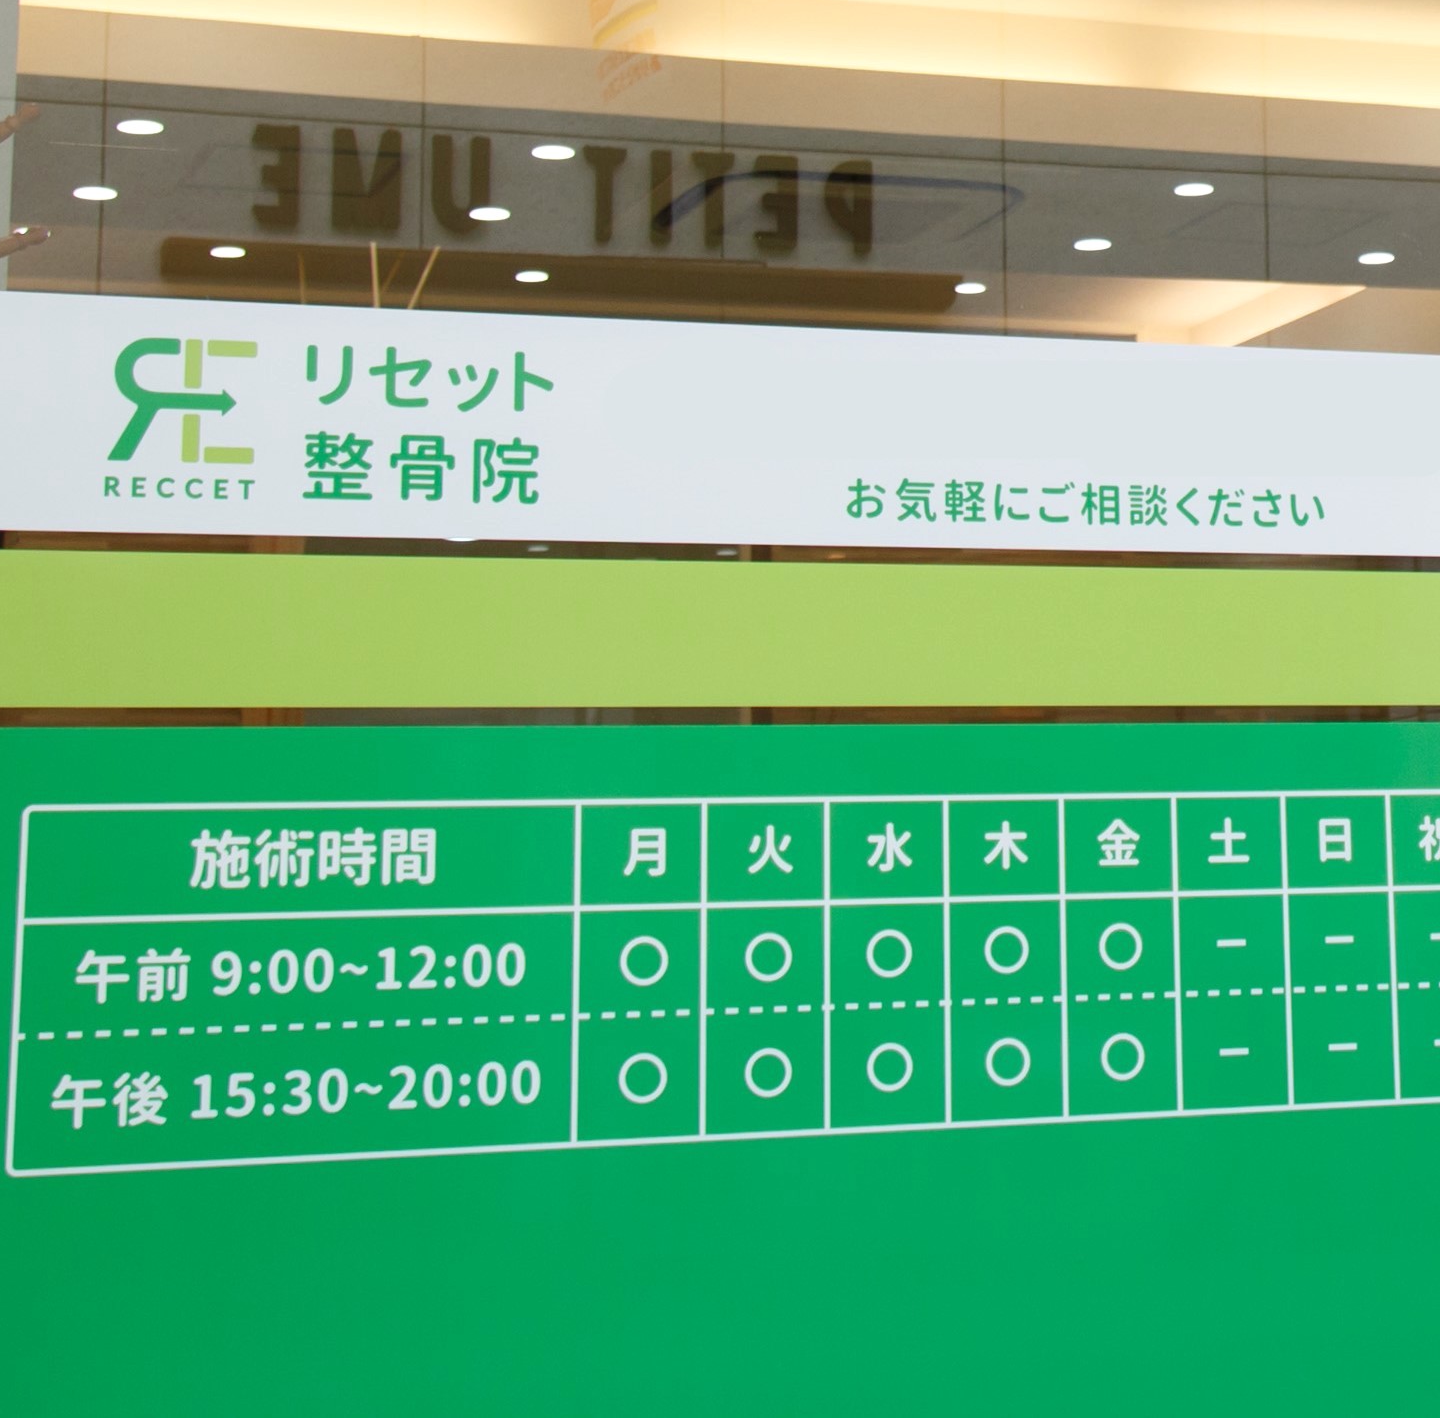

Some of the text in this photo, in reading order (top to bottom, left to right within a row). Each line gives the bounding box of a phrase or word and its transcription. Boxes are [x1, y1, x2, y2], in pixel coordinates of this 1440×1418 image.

[305, 344, 554, 412] リセット
[103, 475, 256, 500] RECCET
[302, 430, 541, 505] 整骨院
[845, 477, 1326, 528] お気軽にご相談ください
[188, 826, 438, 890] 施術時間
[623, 827, 668, 878] 月
[746, 823, 795, 876] 火
[866, 822, 914, 872] 水
[982, 820, 1029, 870] 木
[1096, 817, 1141, 868] 金
[1207, 817, 1251, 865] 土
[1317, 817, 1354, 864] 日
[74, 942, 527, 1004] 午前 9:00~12:00
[49, 1058, 542, 1130] 午後 15:30~20:00
